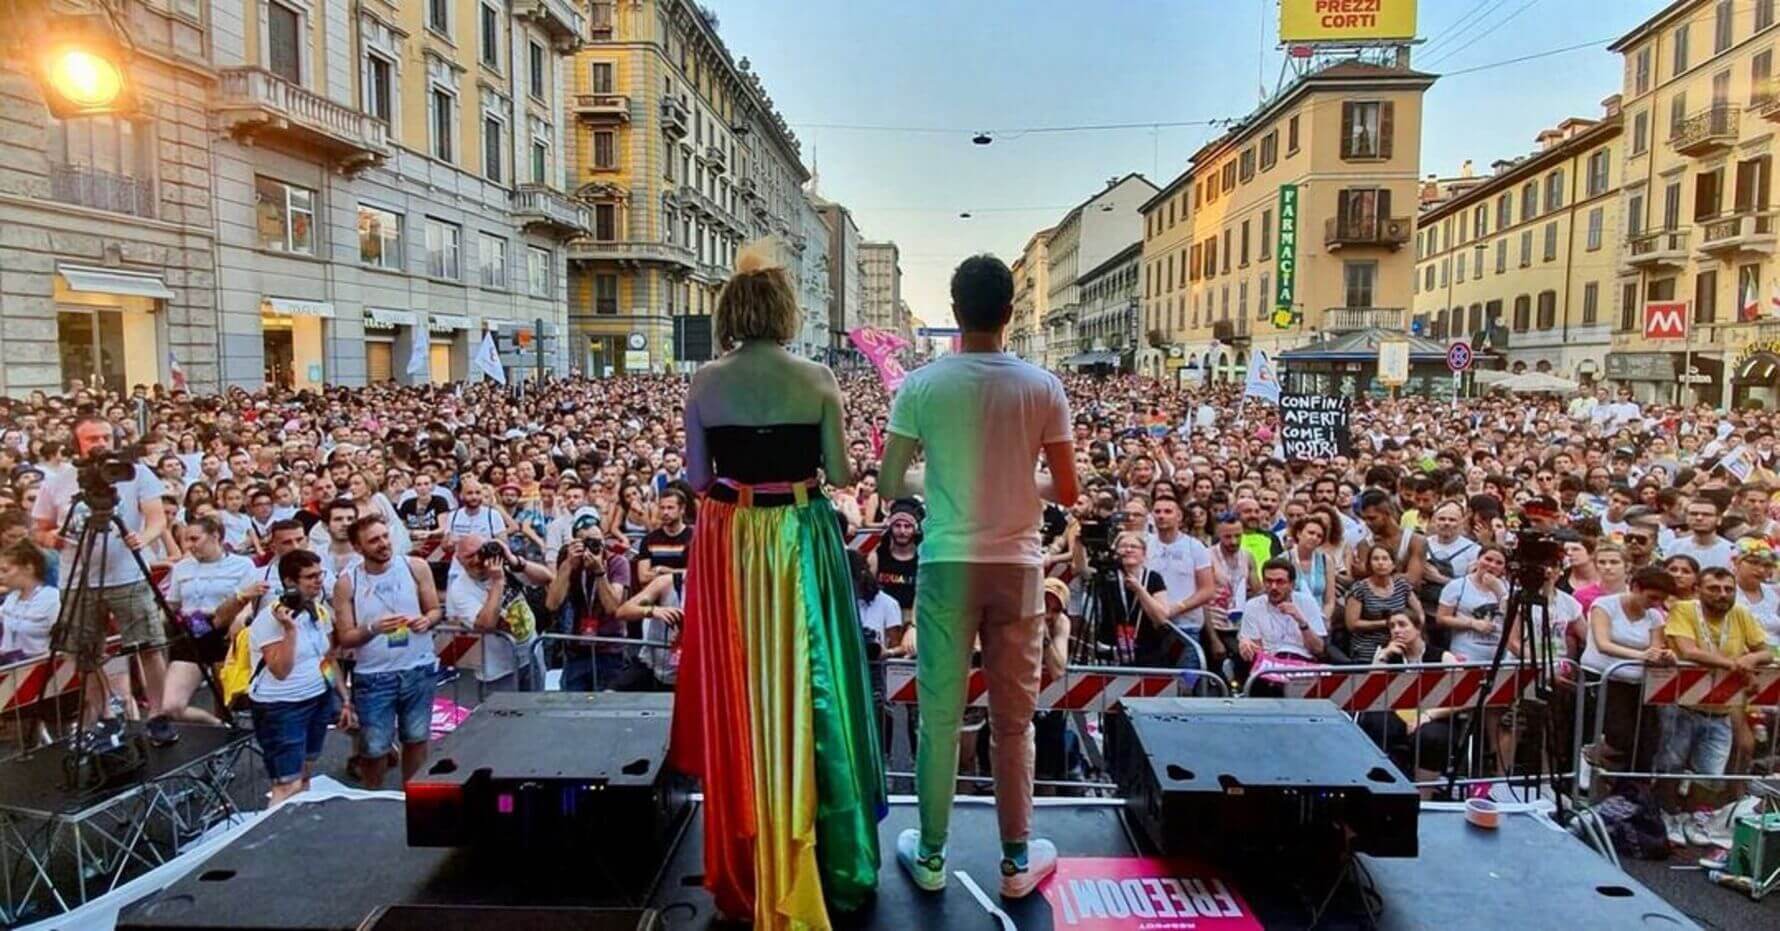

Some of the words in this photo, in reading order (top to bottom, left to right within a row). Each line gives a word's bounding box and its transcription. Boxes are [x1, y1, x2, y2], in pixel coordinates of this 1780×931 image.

[1316, 0, 1381, 13] PREZZI
[1321, 14, 1376, 28] CORTI
[1280, 190, 1295, 300] FARMACIA
[1647, 310, 1684, 333] M
[1282, 426, 1325, 441] COME
[1058, 878, 1243, 925] FREEDOM!
